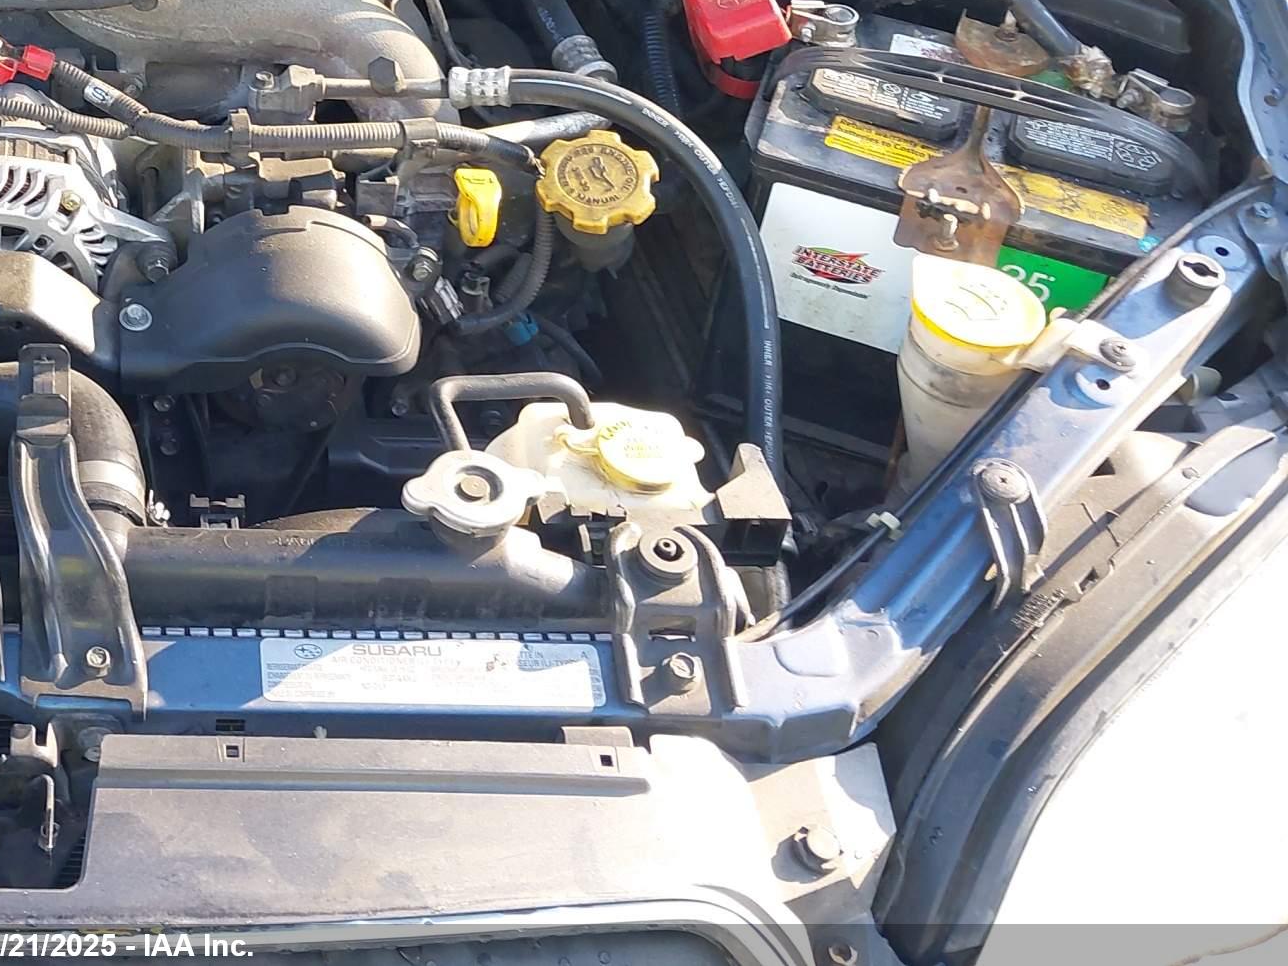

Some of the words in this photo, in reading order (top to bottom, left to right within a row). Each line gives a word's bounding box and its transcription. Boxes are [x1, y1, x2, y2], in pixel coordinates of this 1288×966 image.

[793, 245, 885, 274] INTERSTATE
[795, 255, 872, 283] BATTERIES
[764, 398, 774, 427] OUTER
[352, 644, 442, 657] SUBARU
